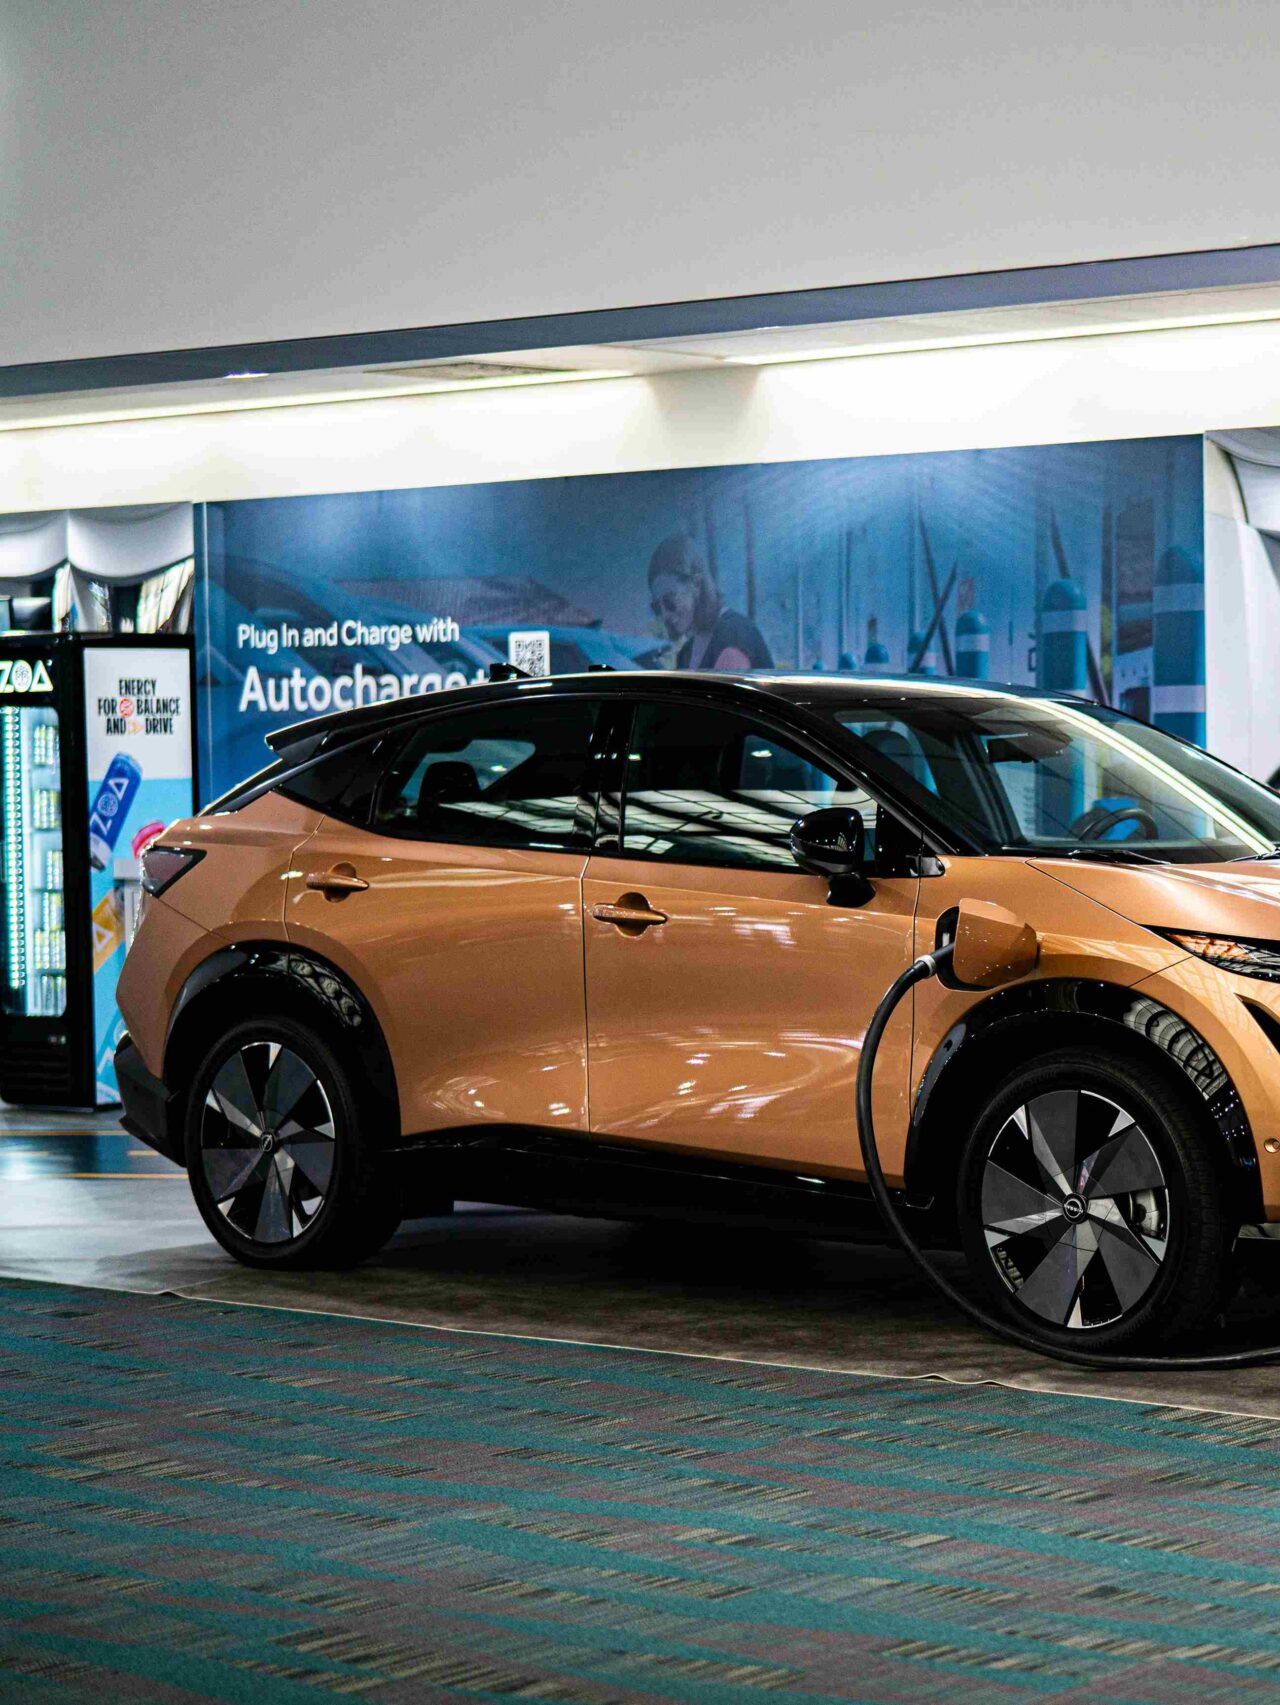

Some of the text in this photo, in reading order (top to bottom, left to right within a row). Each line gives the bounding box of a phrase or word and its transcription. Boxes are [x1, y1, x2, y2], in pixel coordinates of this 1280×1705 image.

[237, 616, 460, 655] Plug In and Charge with
[0, 659, 54, 694] ZOA
[118, 679, 157, 697] ENERGY
[97, 698, 181, 716] FOR BALANCE
[106, 718, 174, 735] AND DRIVE
